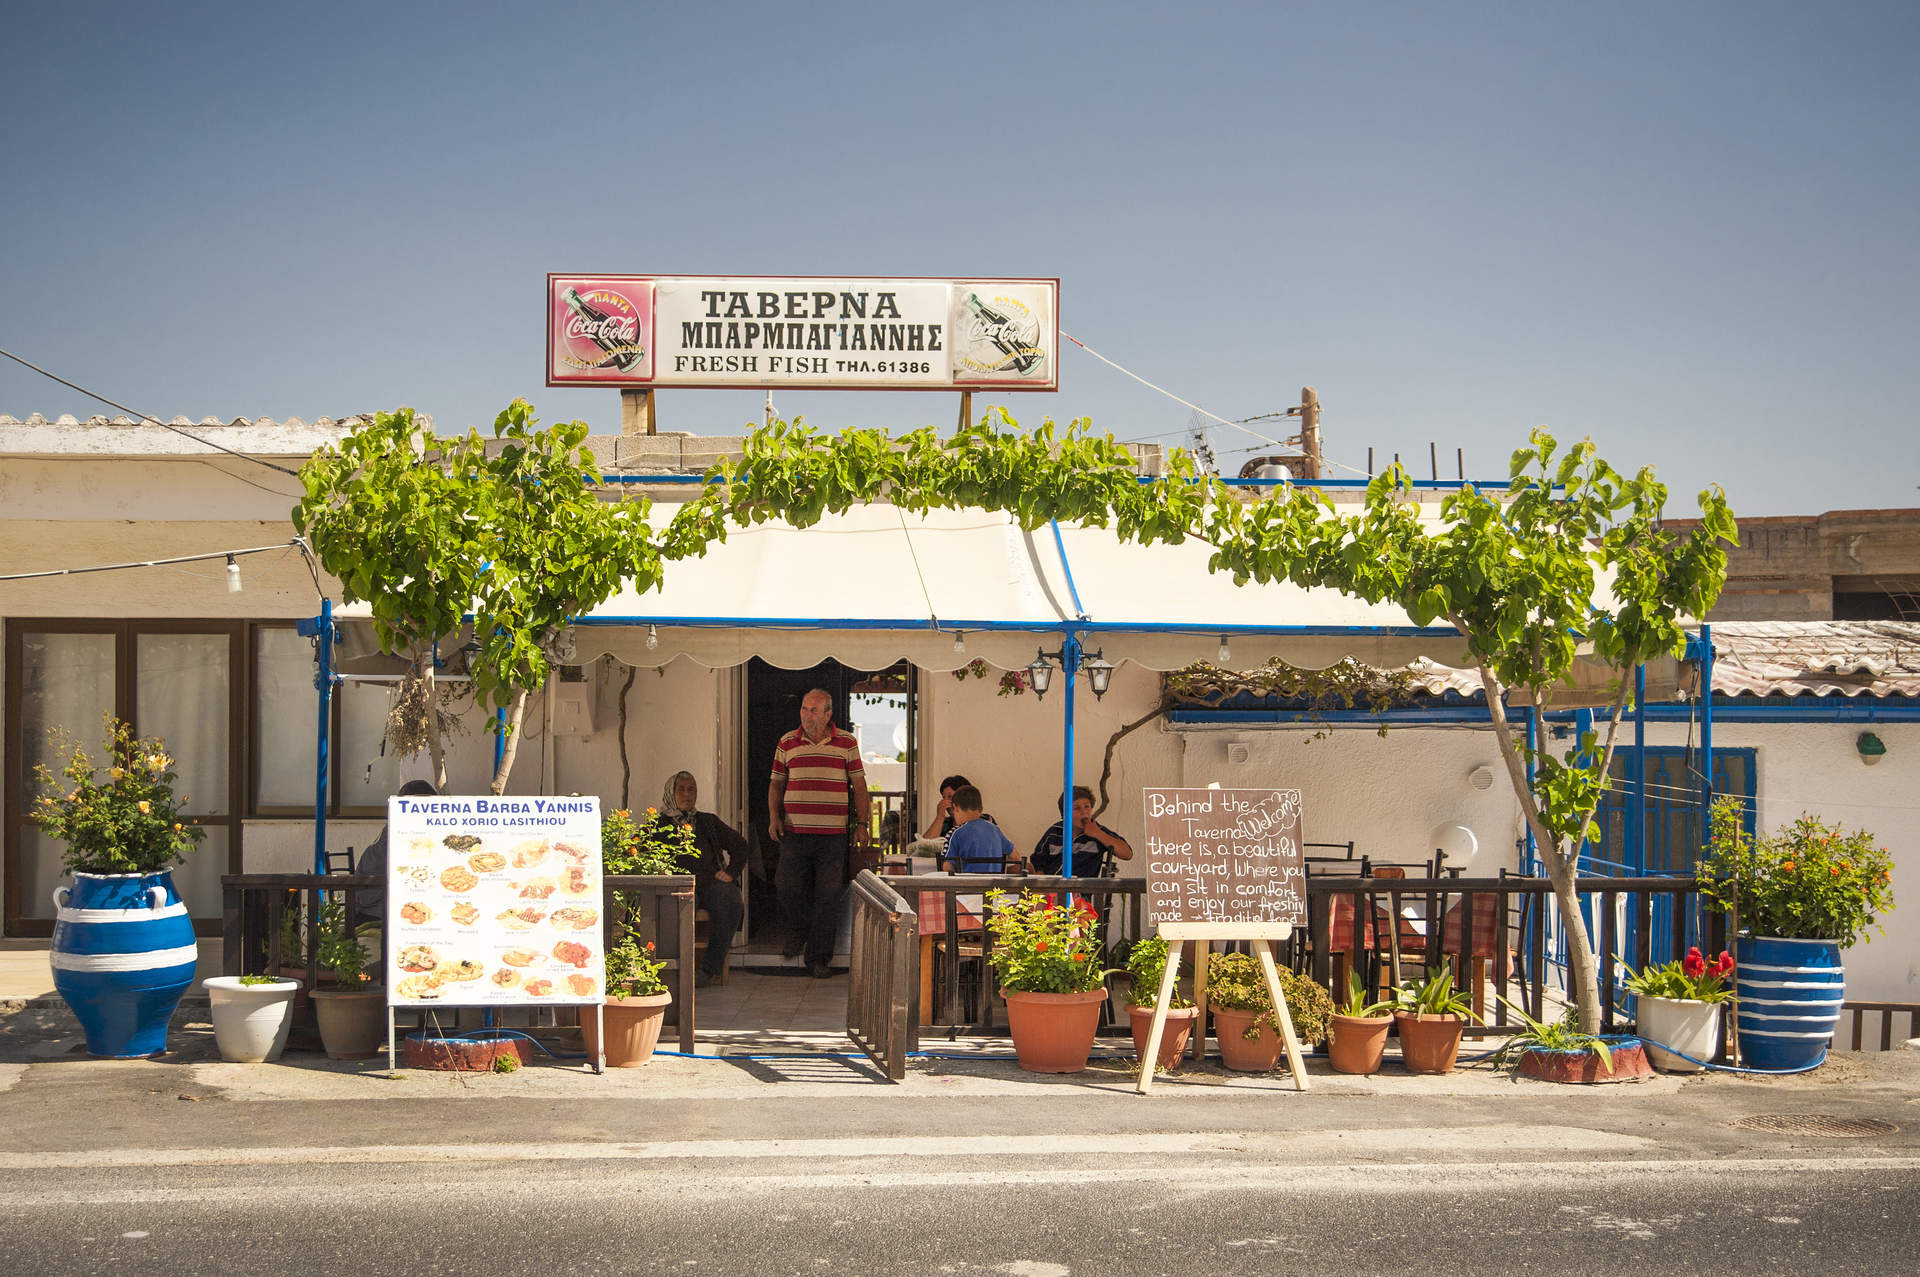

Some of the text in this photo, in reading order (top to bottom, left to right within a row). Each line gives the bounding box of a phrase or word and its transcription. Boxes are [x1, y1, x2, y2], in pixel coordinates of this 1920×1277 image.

[701, 290, 901, 319] ΤΑΒΕΡΝΑ
[566, 315, 637, 339] Coca-Cola
[681, 321, 942, 352] ΜΠΑΡΜΠΑΓΙΑΝΝΗΣ
[674, 355, 759, 373] FRESH
[768, 355, 828, 374] FISH
[399, 799, 593, 813] TAVERNA BARBA YANNIS
[1149, 792, 1250, 817] Behind the
[426, 817, 566, 826] KALO XORIO LASITHIOU
[1240, 793, 1299, 836] Welcome
[1148, 836, 1192, 855] there
[1233, 837, 1296, 857] beautiful
[1270, 866, 1304, 884] you
[1151, 881, 1180, 893] can
[1187, 877, 1208, 894] sit
[1216, 881, 1229, 894] in
[1157, 896, 1181, 908] and
[1188, 897, 1225, 914] enjoy
[1231, 898, 1256, 908] our
[1151, 909, 1183, 921] made
